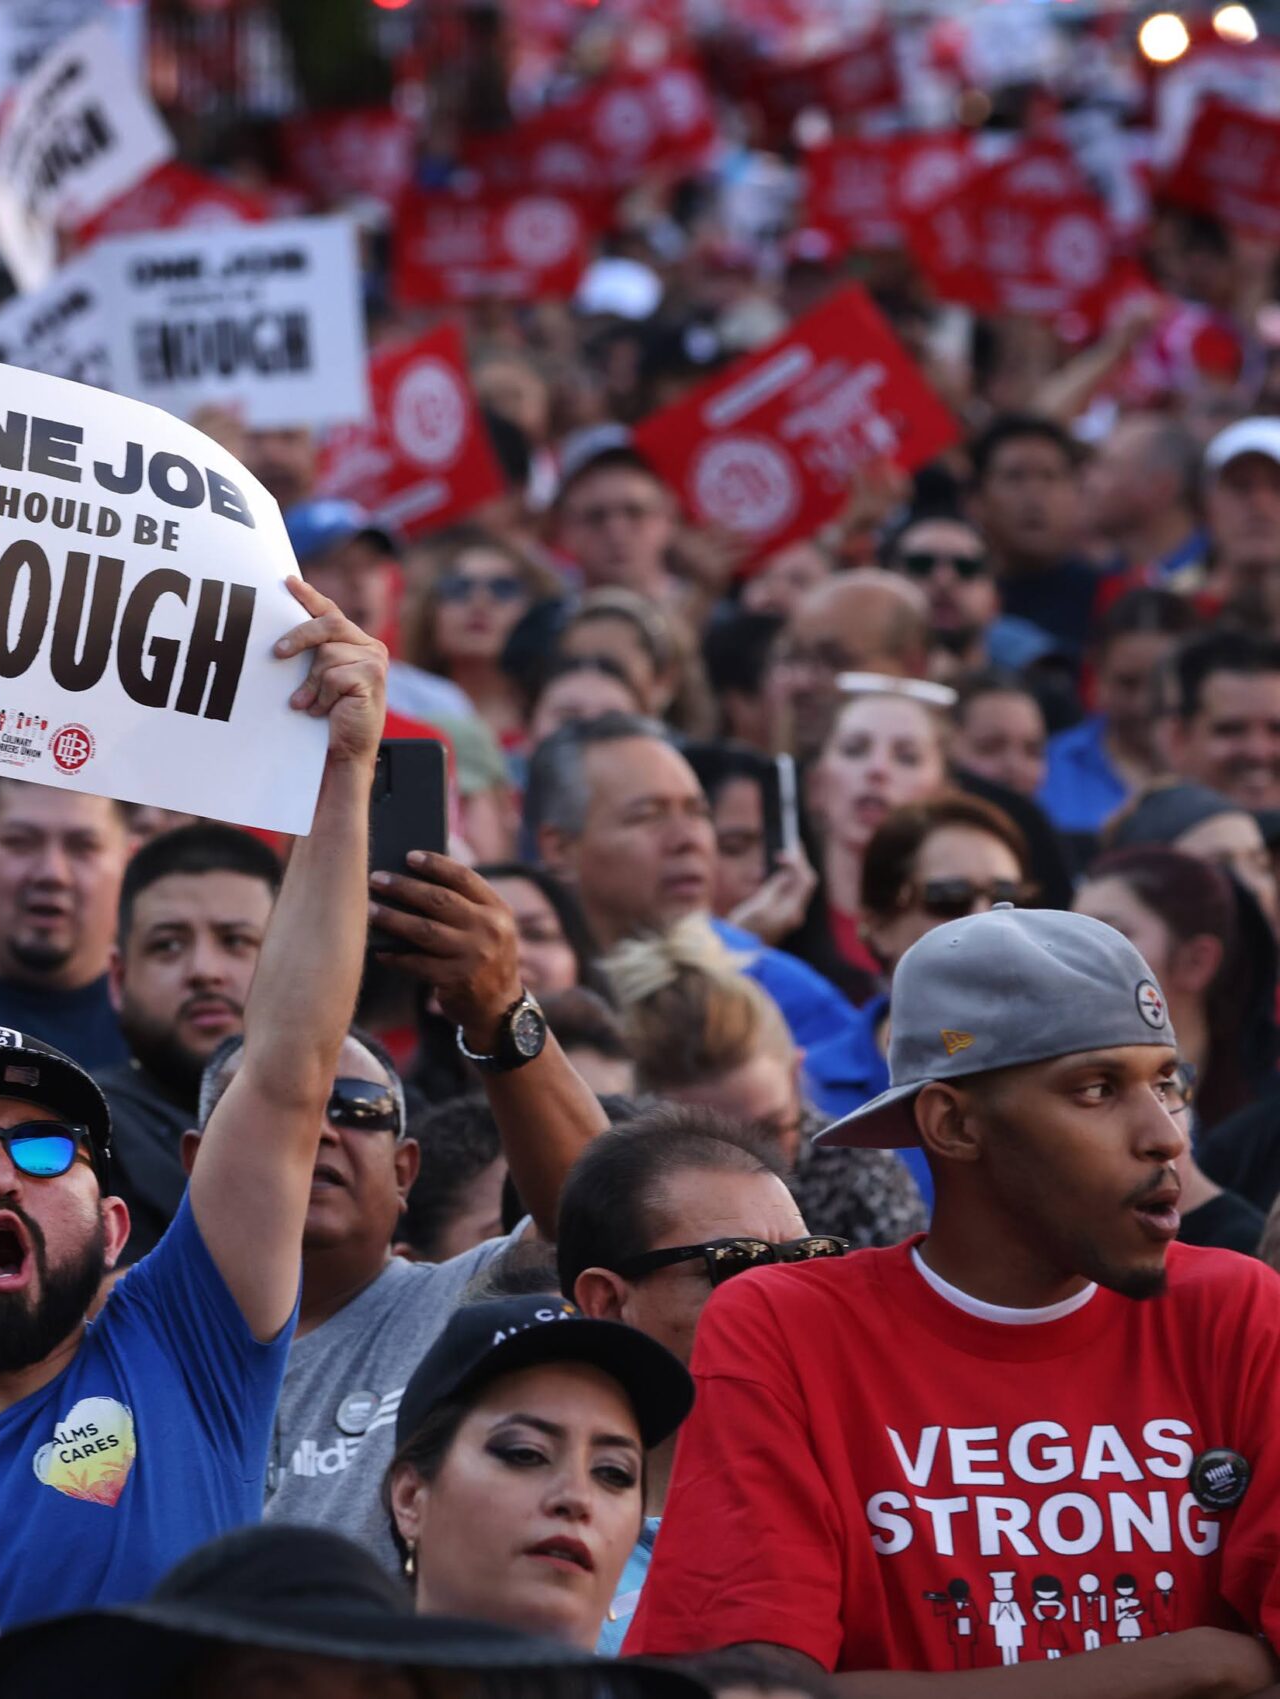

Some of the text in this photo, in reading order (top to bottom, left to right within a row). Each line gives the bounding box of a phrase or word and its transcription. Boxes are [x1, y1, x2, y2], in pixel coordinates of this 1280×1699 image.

[93, 441, 256, 529] JOB
[133, 513, 180, 552] BE
[60, 1434, 119, 1464] CARES
[885, 1418, 1194, 1487] VEGAS
[866, 1490, 1220, 1557] STRONG
